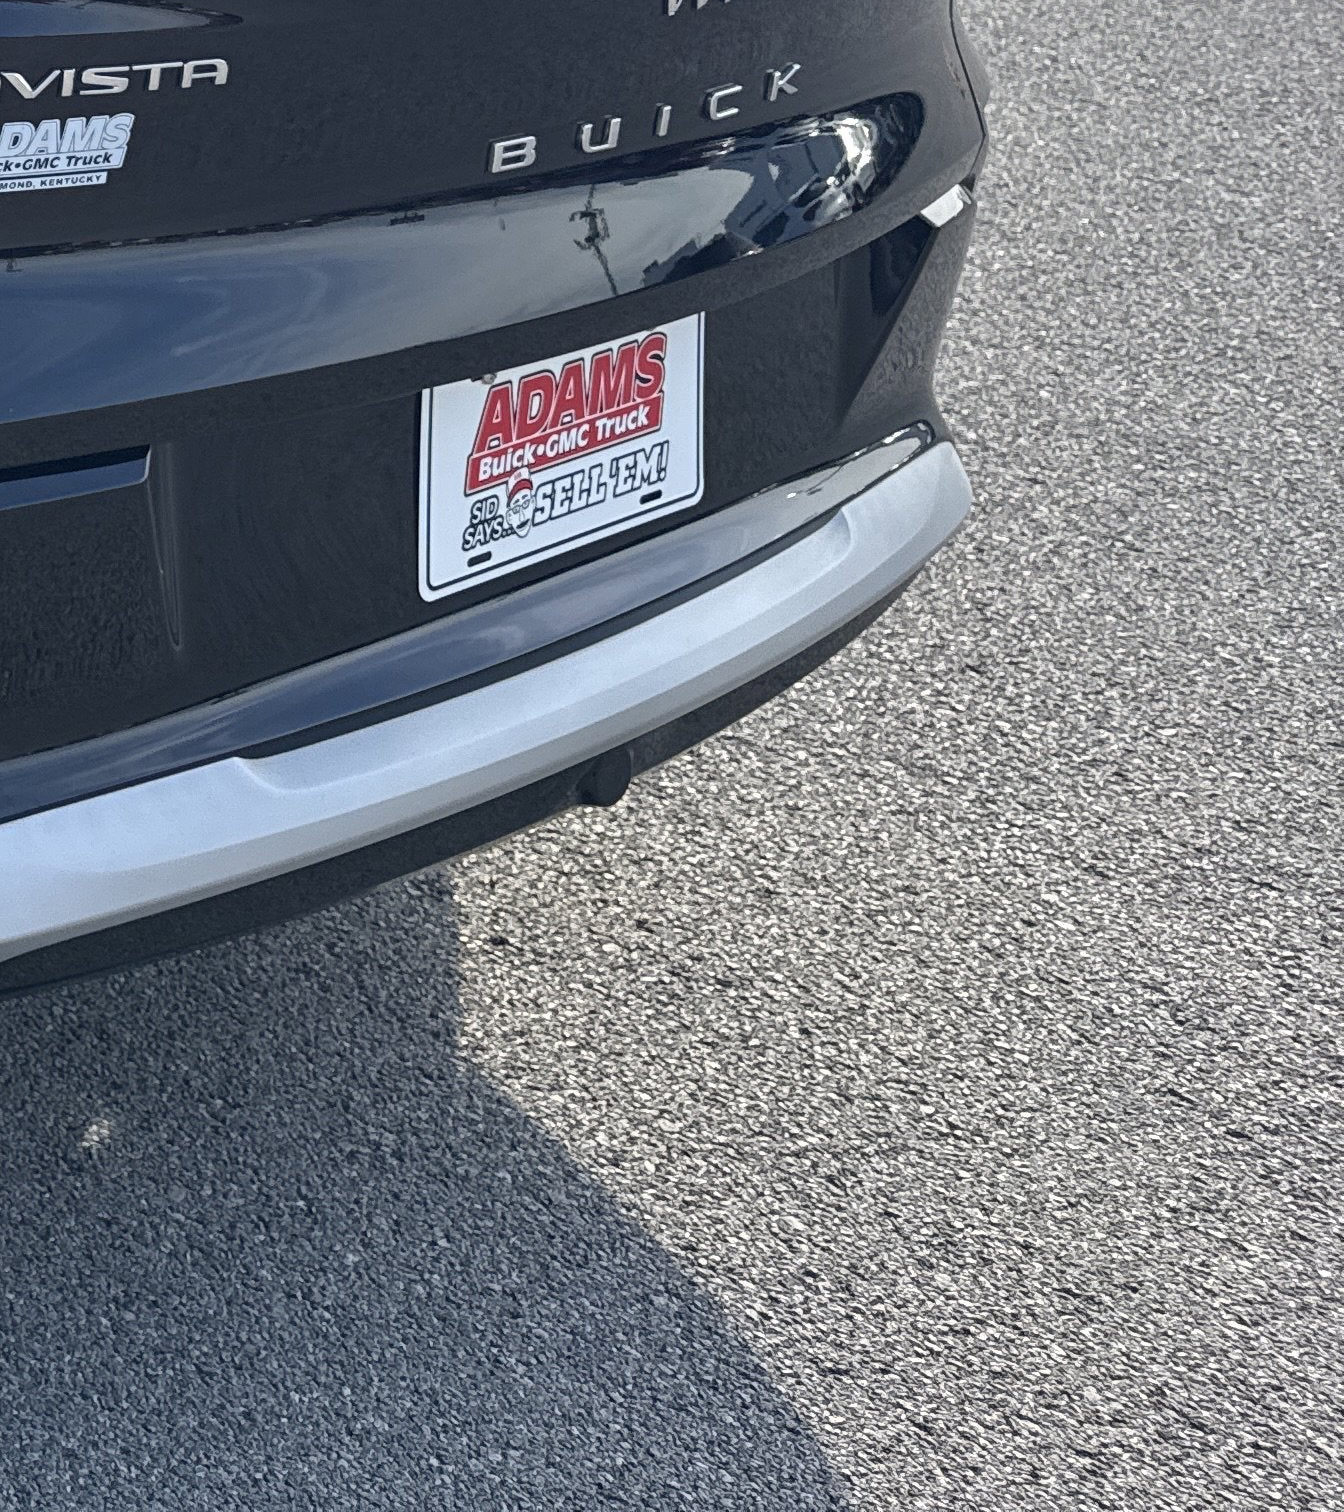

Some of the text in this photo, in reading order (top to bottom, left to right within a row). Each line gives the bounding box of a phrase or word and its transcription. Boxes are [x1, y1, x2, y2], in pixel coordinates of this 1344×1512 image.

[488, 62, 802, 174] BUICK
[66, 152, 113, 168] Truck
[40, 174, 102, 188] KENTUCKY
[473, 332, 667, 455] ADAMS
[595, 404, 651, 441] Truck
[470, 494, 499, 525] SID
[532, 462, 608, 527] SELL
